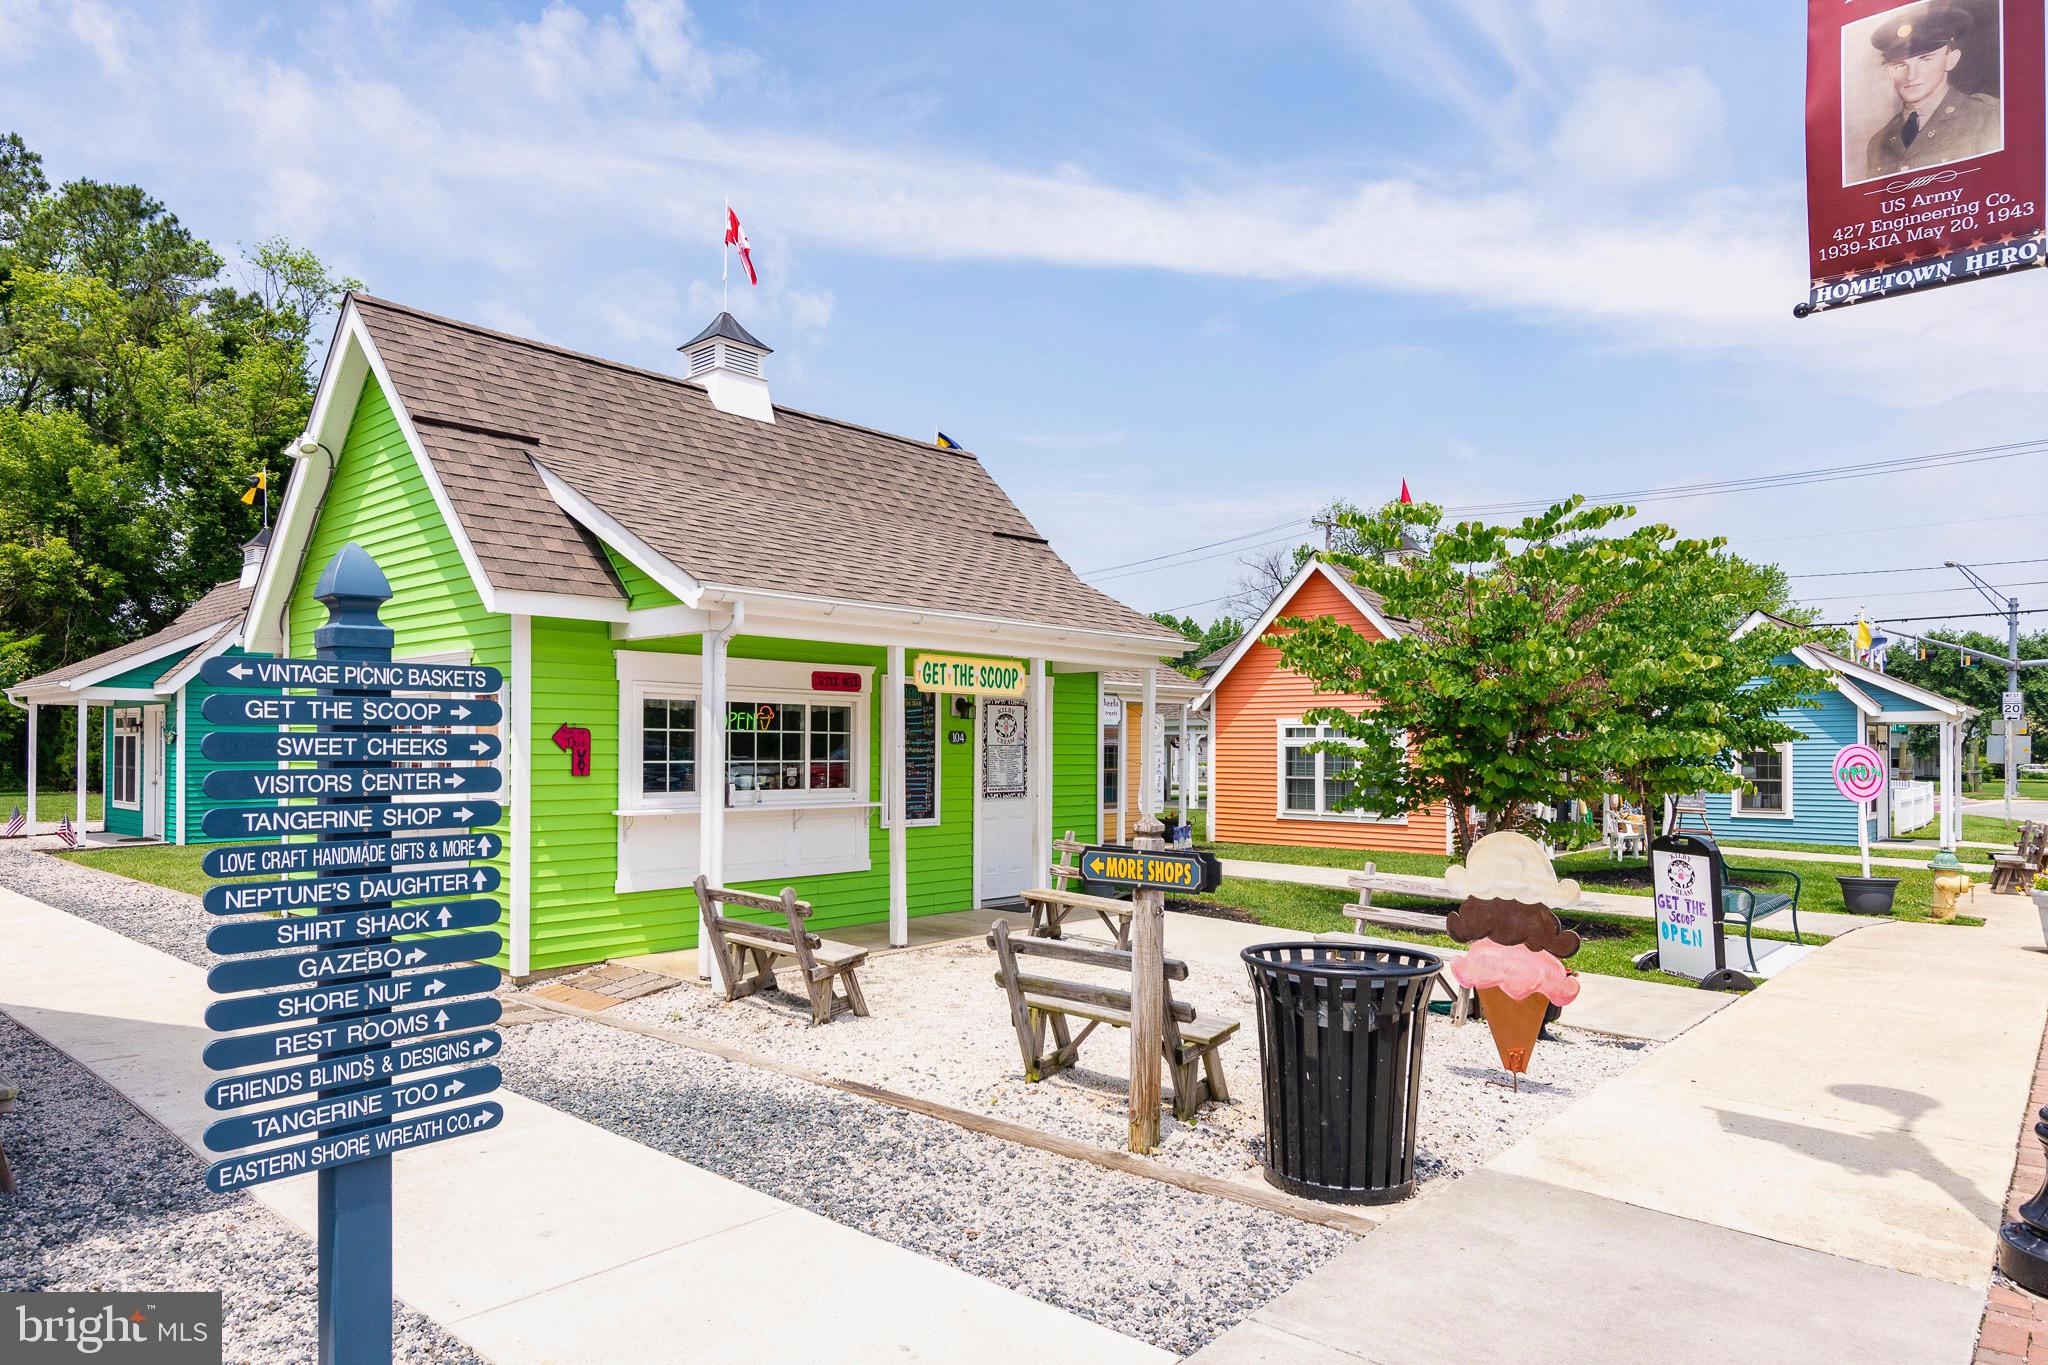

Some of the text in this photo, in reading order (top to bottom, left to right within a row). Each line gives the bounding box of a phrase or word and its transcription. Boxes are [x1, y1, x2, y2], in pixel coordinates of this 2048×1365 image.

[1881, 186, 1964, 213] US Army
[1820, 200, 2034, 261] 1939-KIA May 20, 1943
[1833, 193, 2016, 241] 427 Engineering Co.
[1814, 241, 2038, 303] HOMETOWN HERO
[258, 664, 486, 687] VINTAGE PICNIC BASKETS
[923, 662, 1018, 689] GET THE SCOOP
[245, 700, 440, 720] GET THE SCOOP
[2004, 704, 2020, 713] 20
[277, 738, 447, 755] SWEET CHEEKS
[952, 732, 965, 743] 104
[254, 772, 440, 793] VISITORS CENTER
[1838, 765, 1883, 783] OPEN
[243, 808, 441, 832] TANGERINE SHOP
[221, 840, 475, 872] LOVE CRAFT HANDMADE GIFTS & MORE
[1669, 853, 1692, 862] KILBY
[1106, 857, 1191, 884] MORE SHOPS
[226, 874, 468, 910] NEPTUNE’S DAUGHTER
[1670, 885, 1694, 896] CREAM
[1657, 893, 1708, 917] GET THE
[1669, 911, 1696, 926] SCOOP
[278, 911, 430, 943] SHIRT SHACK
[1661, 920, 1702, 948] OPEN
[297, 947, 401, 977] GAZEBO
[277, 982, 413, 1016] SHORE NUF
[274, 1014, 429, 1056] REST ROOMS
[216, 1040, 471, 1106] FRIENDS BLINDS & DESIGNS
[252, 1083, 439, 1138] TANGERINE TOO
[218, 1112, 473, 1188] EASTERN SHORE WREATH CO.
